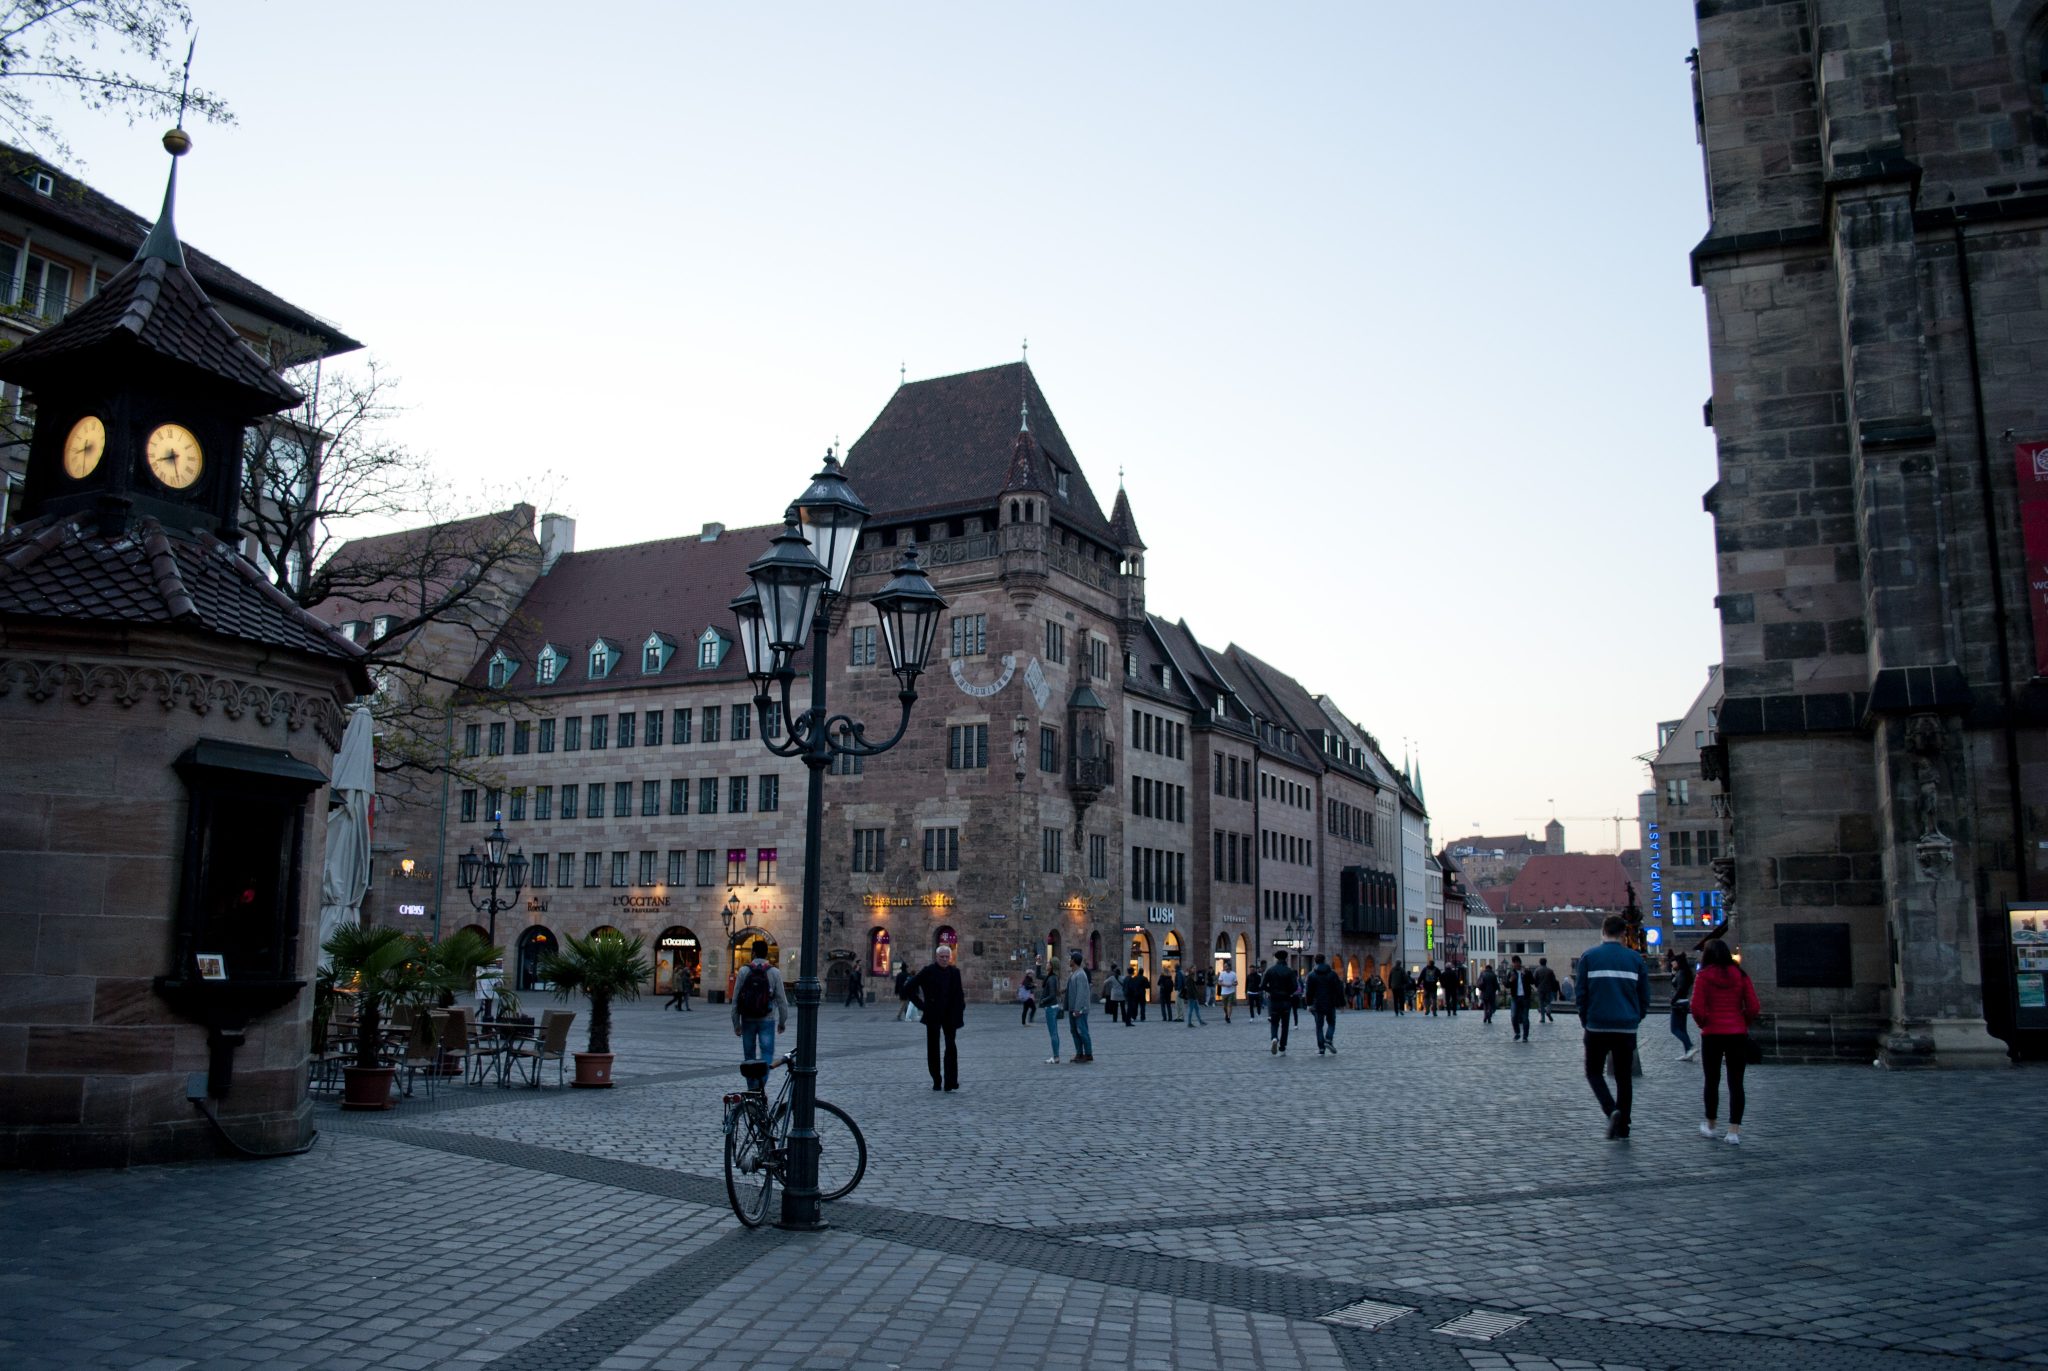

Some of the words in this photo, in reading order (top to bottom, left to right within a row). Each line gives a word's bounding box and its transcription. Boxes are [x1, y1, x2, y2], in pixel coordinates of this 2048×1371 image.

[1648, 823, 1663, 919] FILMPALAST
[613, 895, 671, 907] L'OCCITANE
[863, 894, 914, 906] Nassauer
[1148, 906, 1175, 924] LUSH
[662, 938, 696, 947] L'OCCITANE
